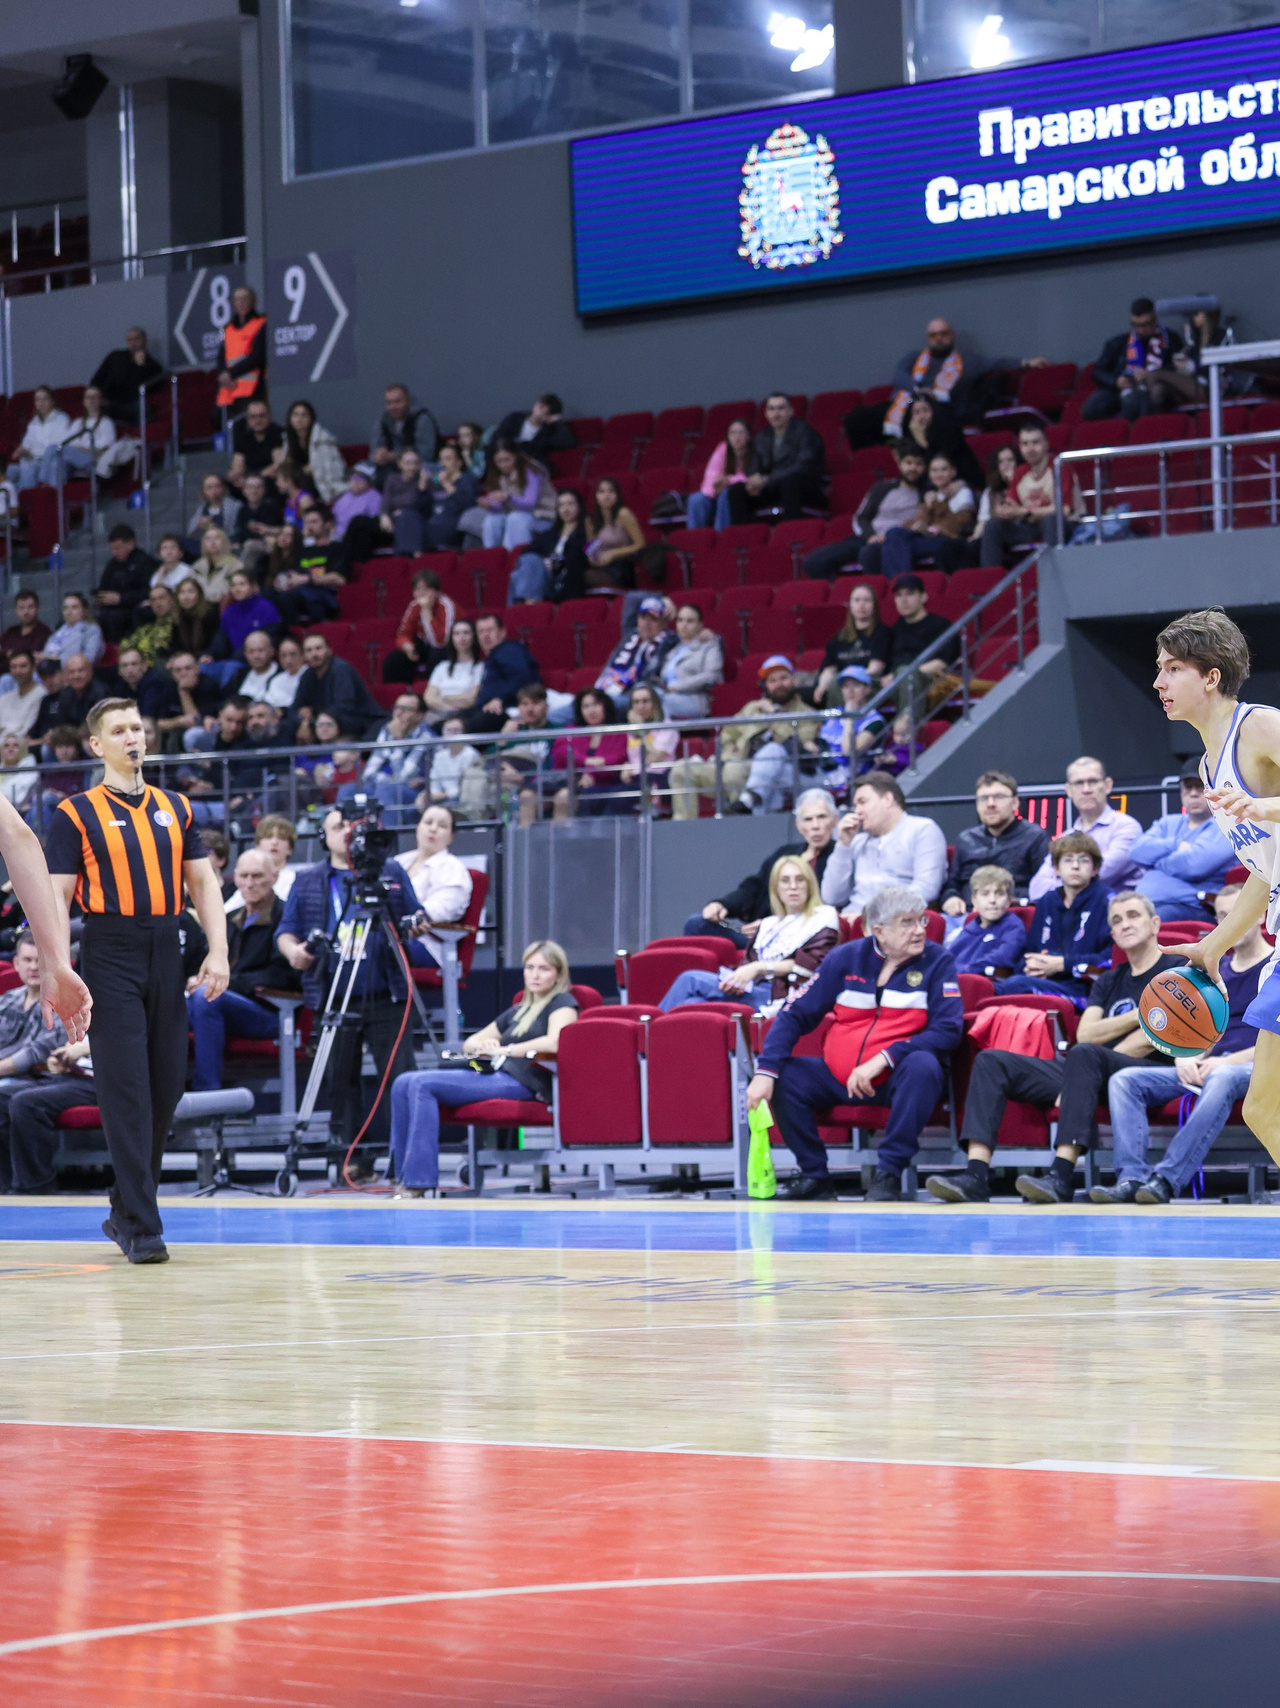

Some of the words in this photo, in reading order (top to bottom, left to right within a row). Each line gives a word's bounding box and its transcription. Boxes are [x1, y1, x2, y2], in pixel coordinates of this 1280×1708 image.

[924, 145, 1186, 225] Самарской
[210, 274, 232, 329] 8
[283, 264, 307, 324] 9
[1158, 979, 1198, 1020] JÖGEL
